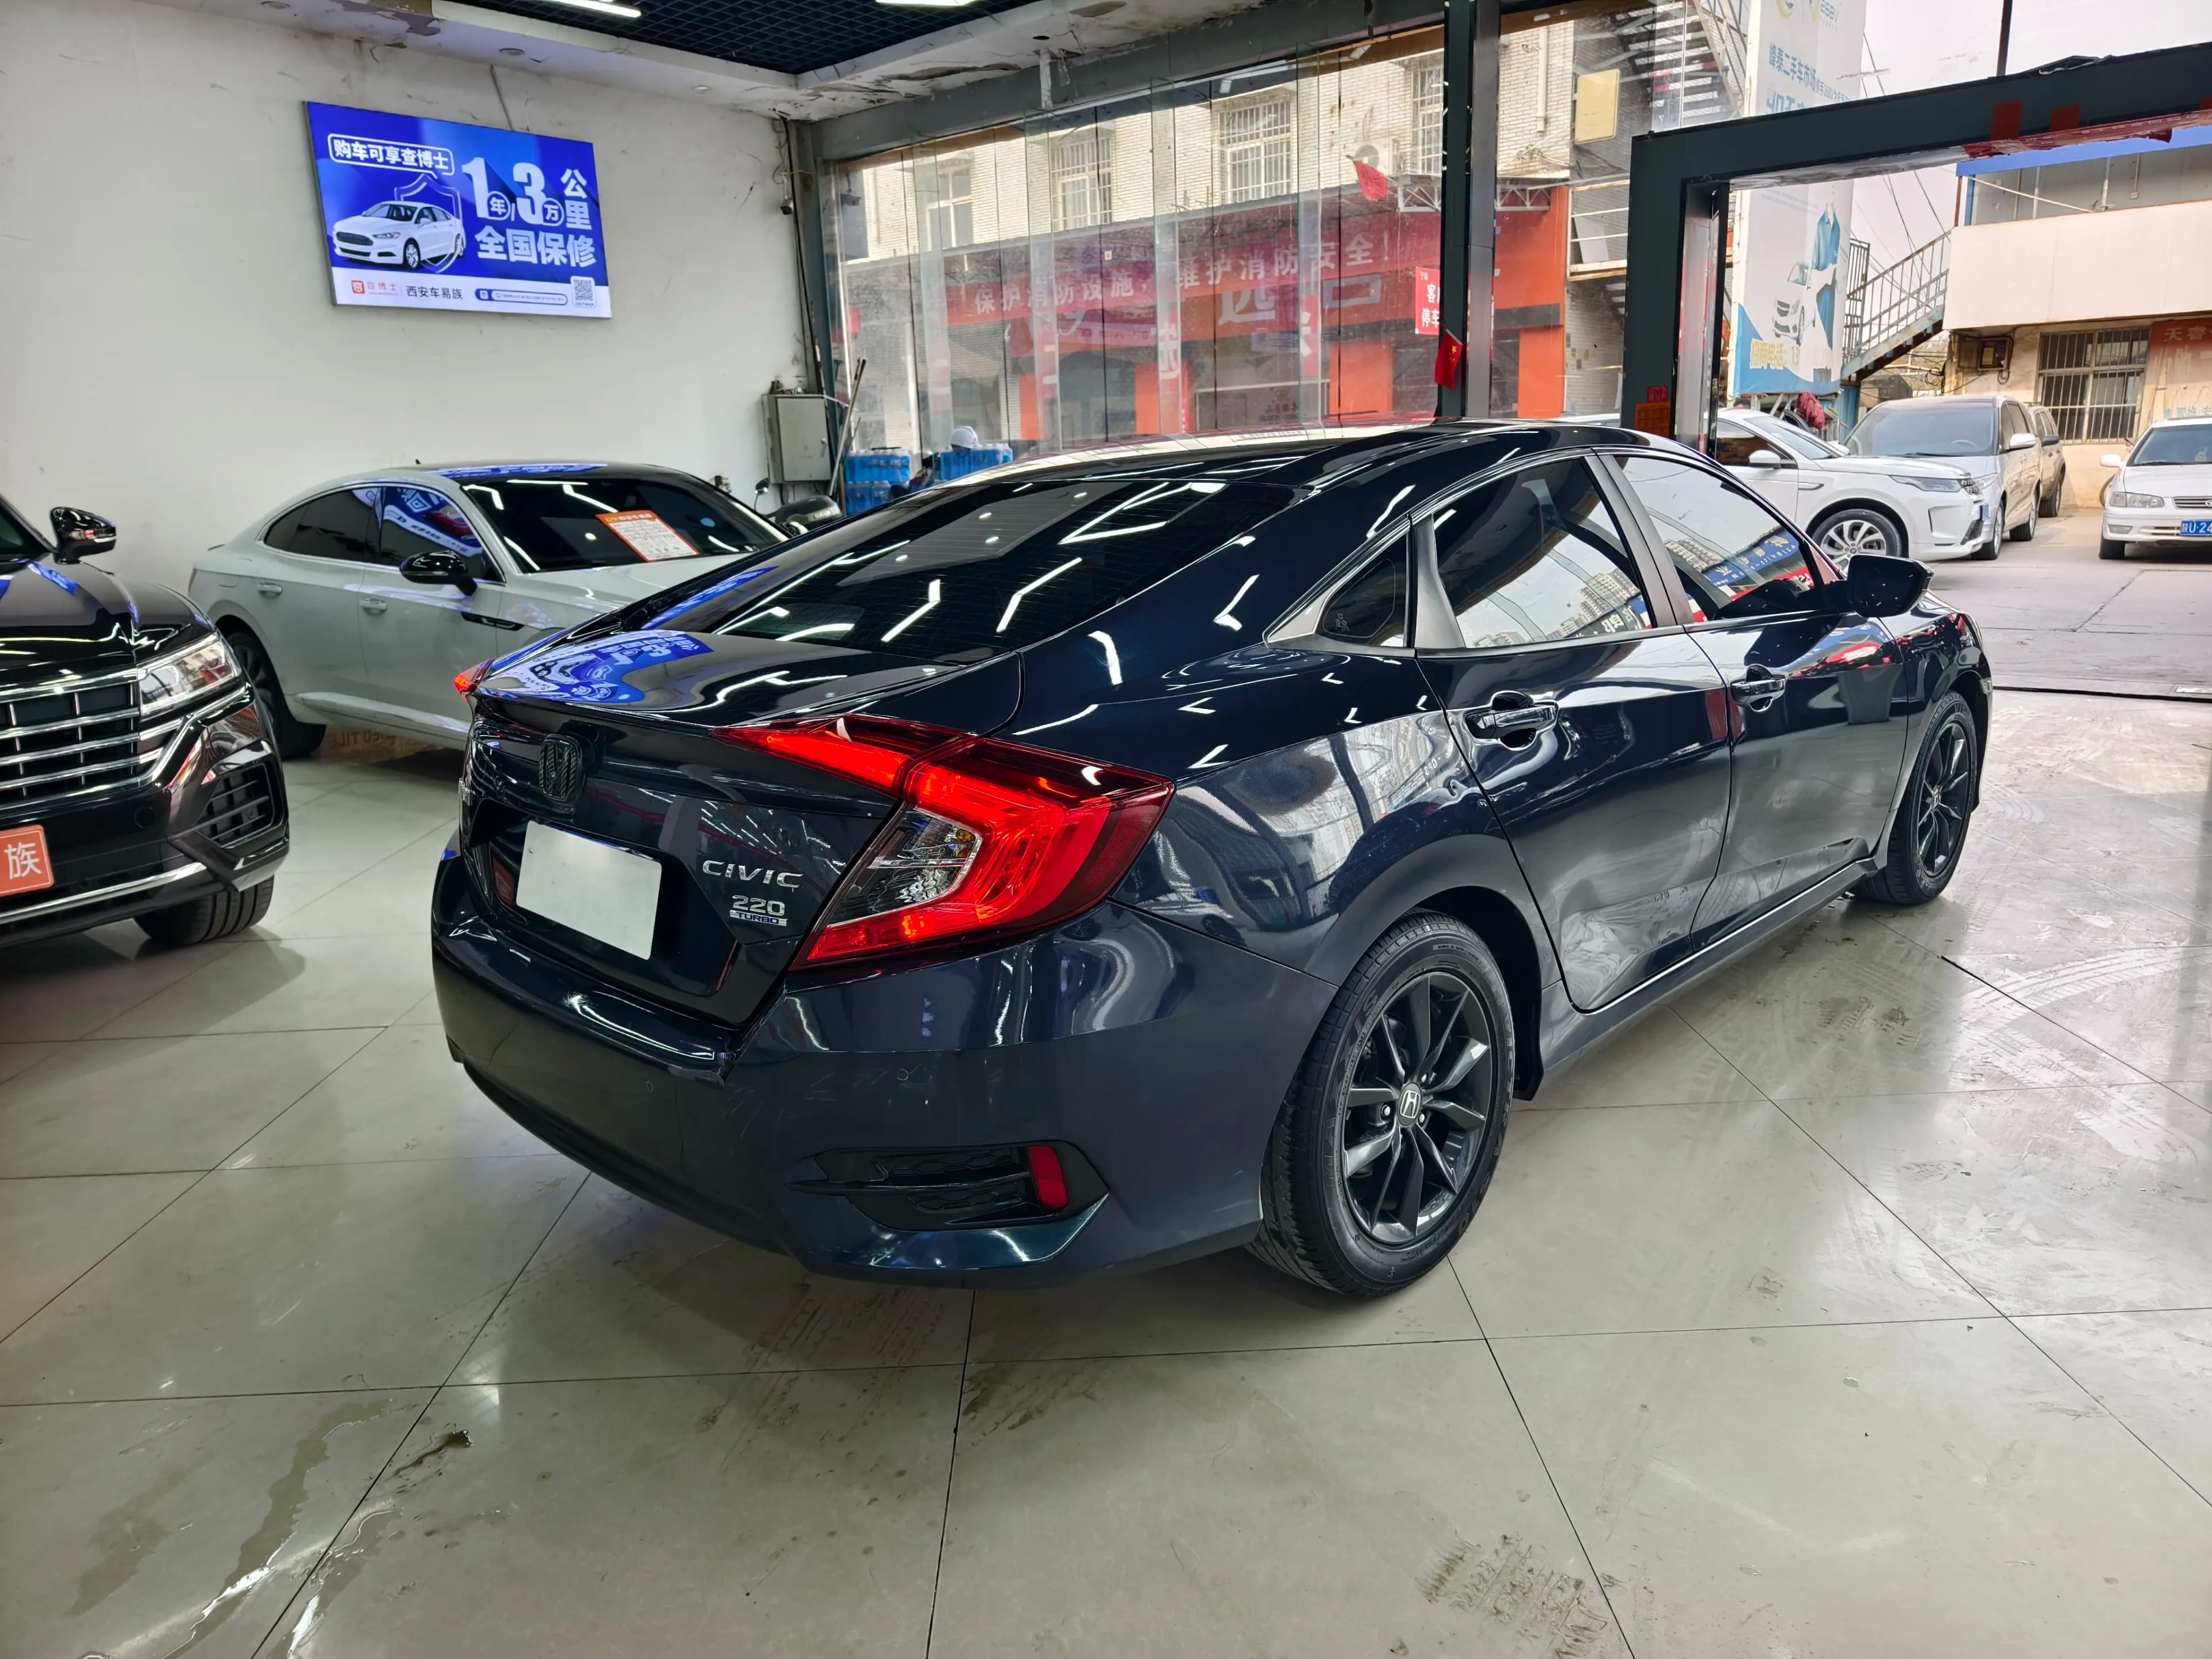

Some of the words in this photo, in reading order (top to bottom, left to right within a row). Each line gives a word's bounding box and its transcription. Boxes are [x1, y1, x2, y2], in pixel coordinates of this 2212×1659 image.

[333, 139, 449, 170] 购车可享查博士
[474, 225, 596, 267] 全国保修
[406, 285, 463, 299] 西安车易族
[4, 842, 42, 880] 族
[703, 860, 804, 888] CIVIC
[732, 895, 785, 916] 220
[737, 912, 781, 925] TURBO
